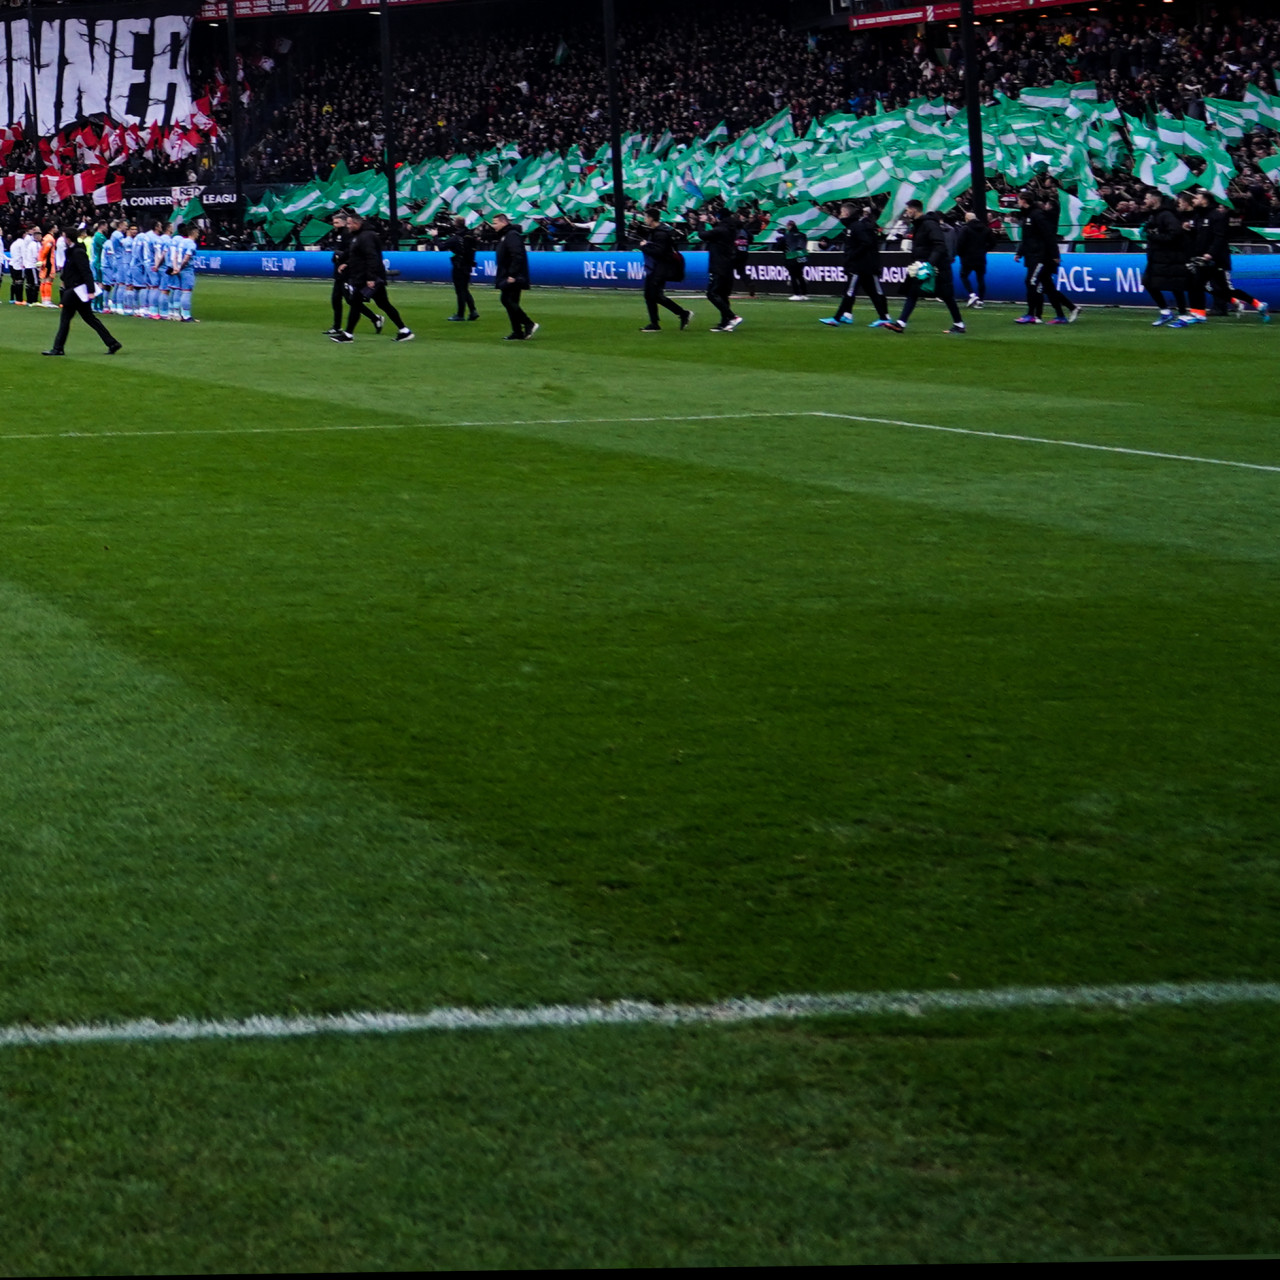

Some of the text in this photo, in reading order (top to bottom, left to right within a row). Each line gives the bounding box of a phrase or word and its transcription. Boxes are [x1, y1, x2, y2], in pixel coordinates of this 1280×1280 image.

[203, 194, 237, 204] LEAGU
[583, 261, 618, 280] PEACE
[1056, 266, 1096, 292] ACE
